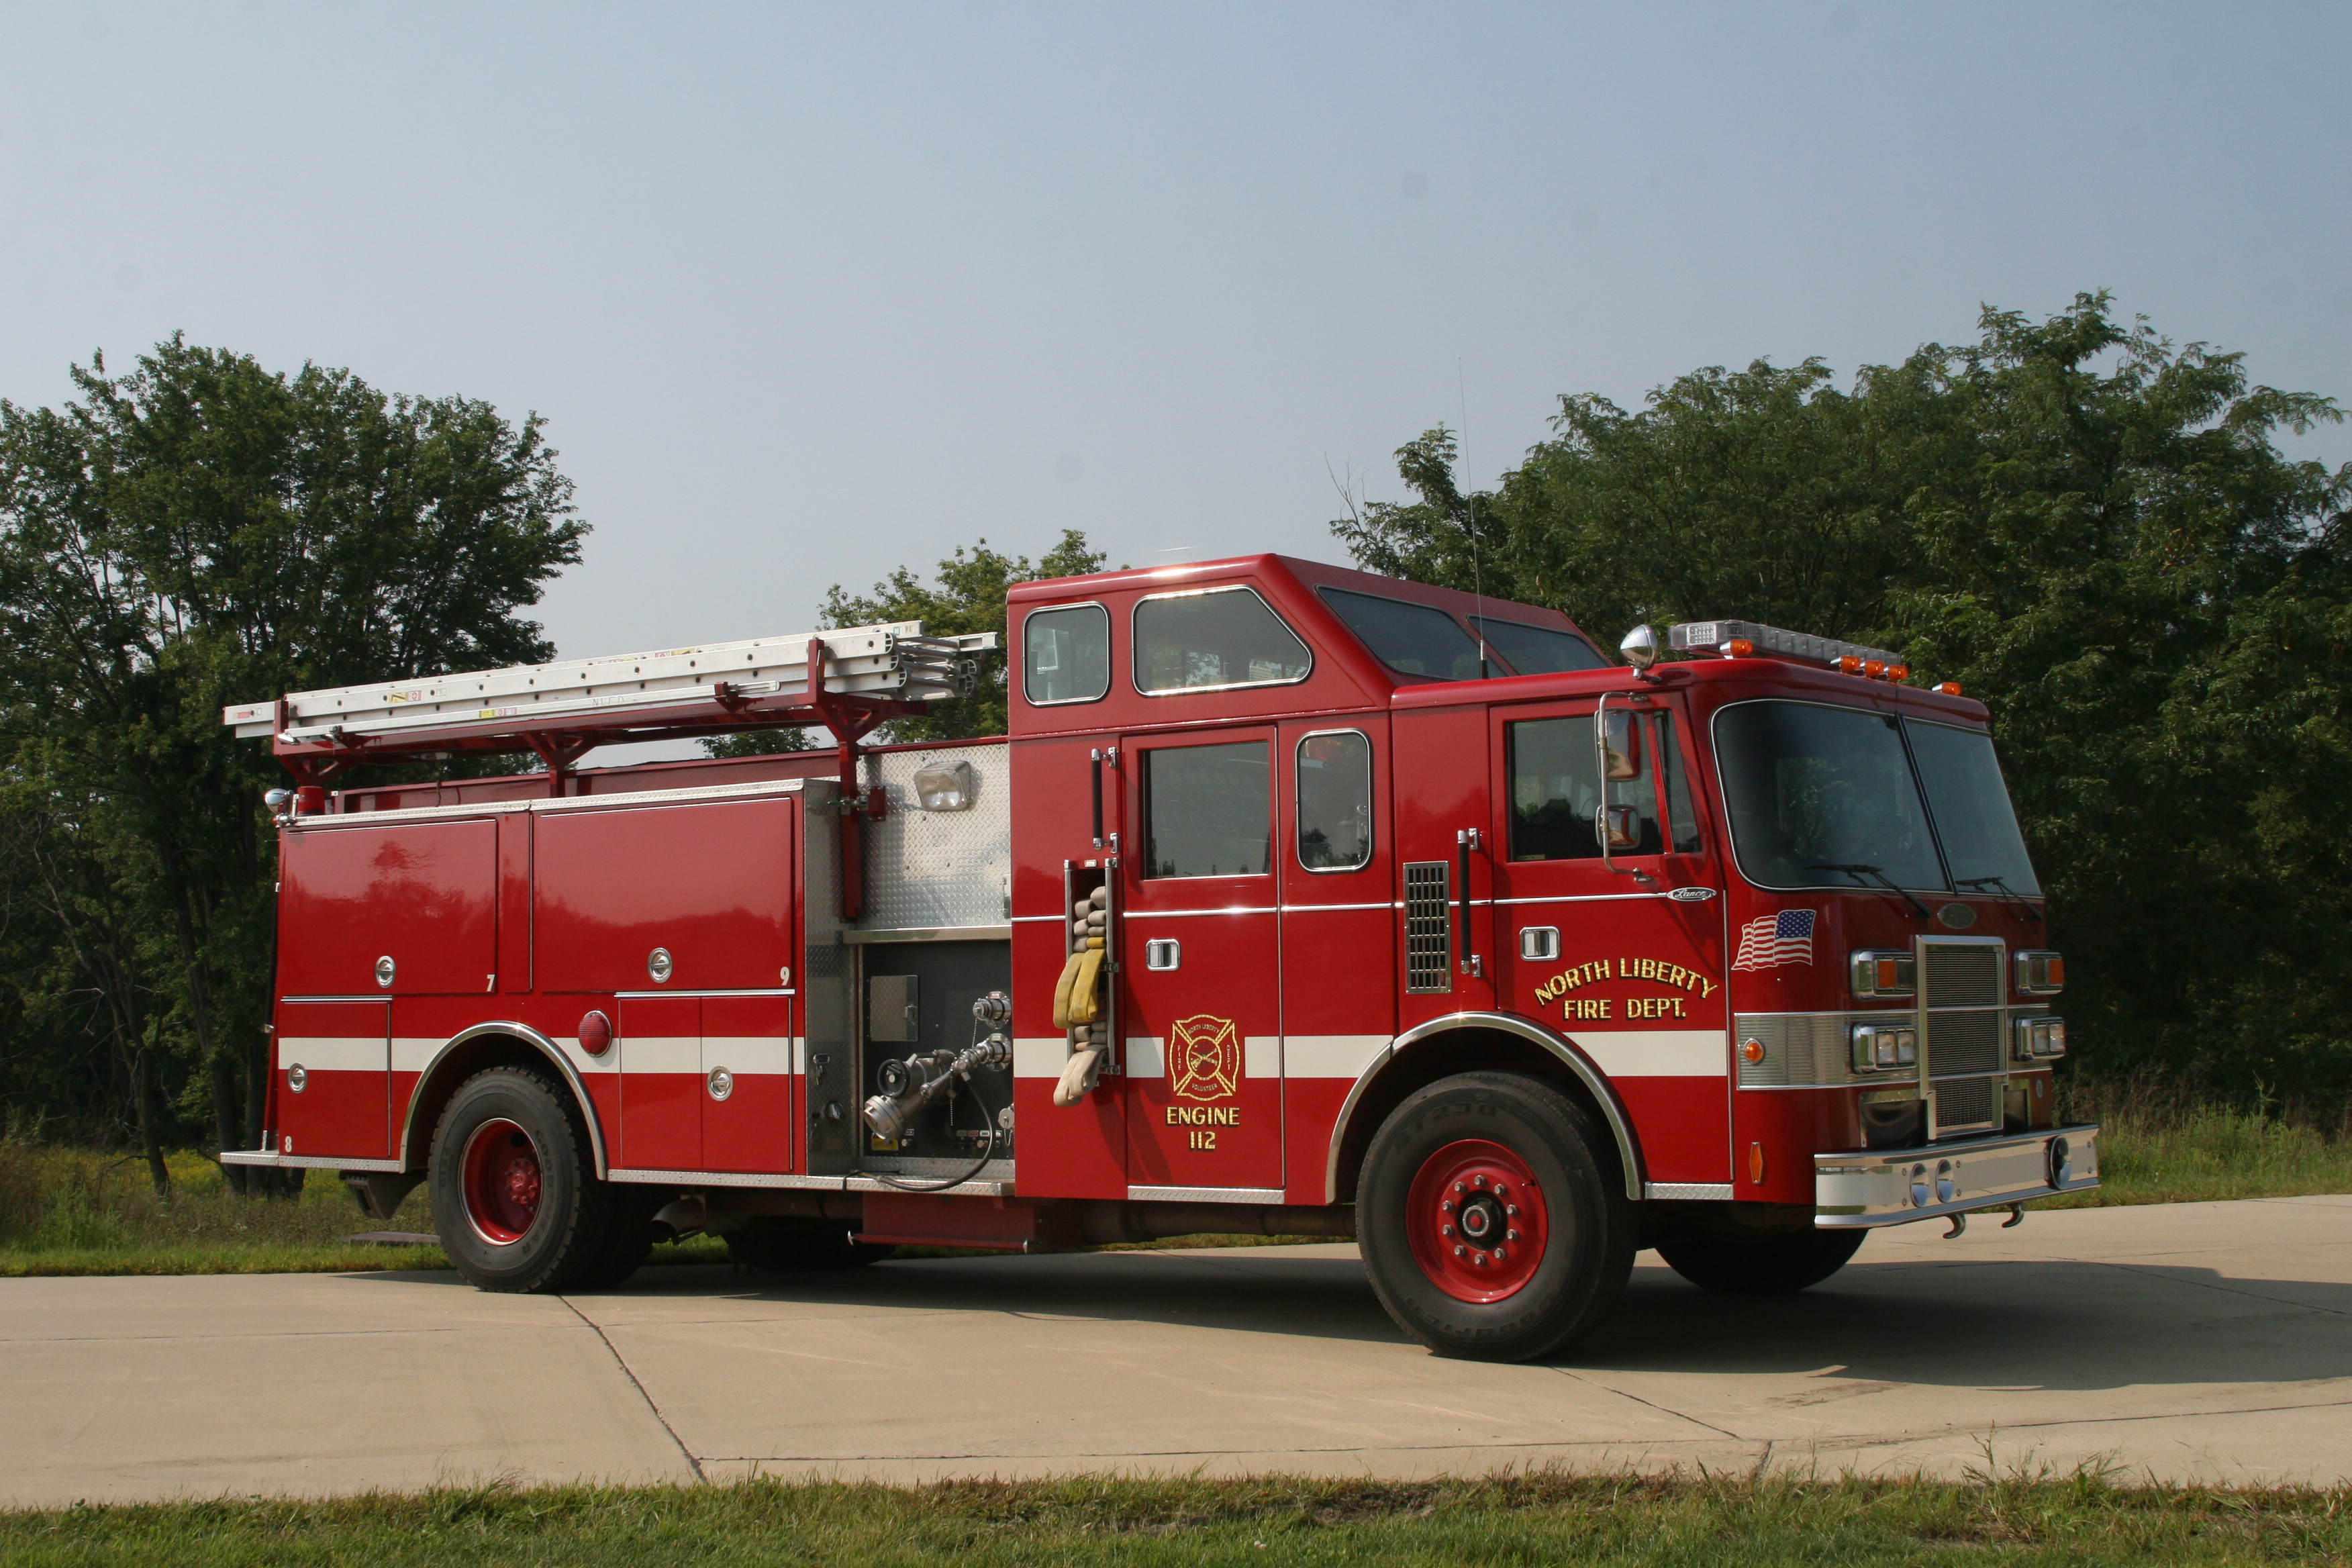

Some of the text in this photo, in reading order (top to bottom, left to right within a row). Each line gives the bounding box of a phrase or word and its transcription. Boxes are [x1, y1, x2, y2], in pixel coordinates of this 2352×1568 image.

[487, 974, 495, 992] 7
[780, 966, 789, 985] 9
[1534, 958, 1718, 1006] NORTH LIBERTY
[1564, 997, 1686, 1019] FIRE DEPT.
[1167, 1107, 1240, 1125] ENGINE
[285, 1135, 293, 1153] 8
[1190, 1131, 1216, 1149] 112
